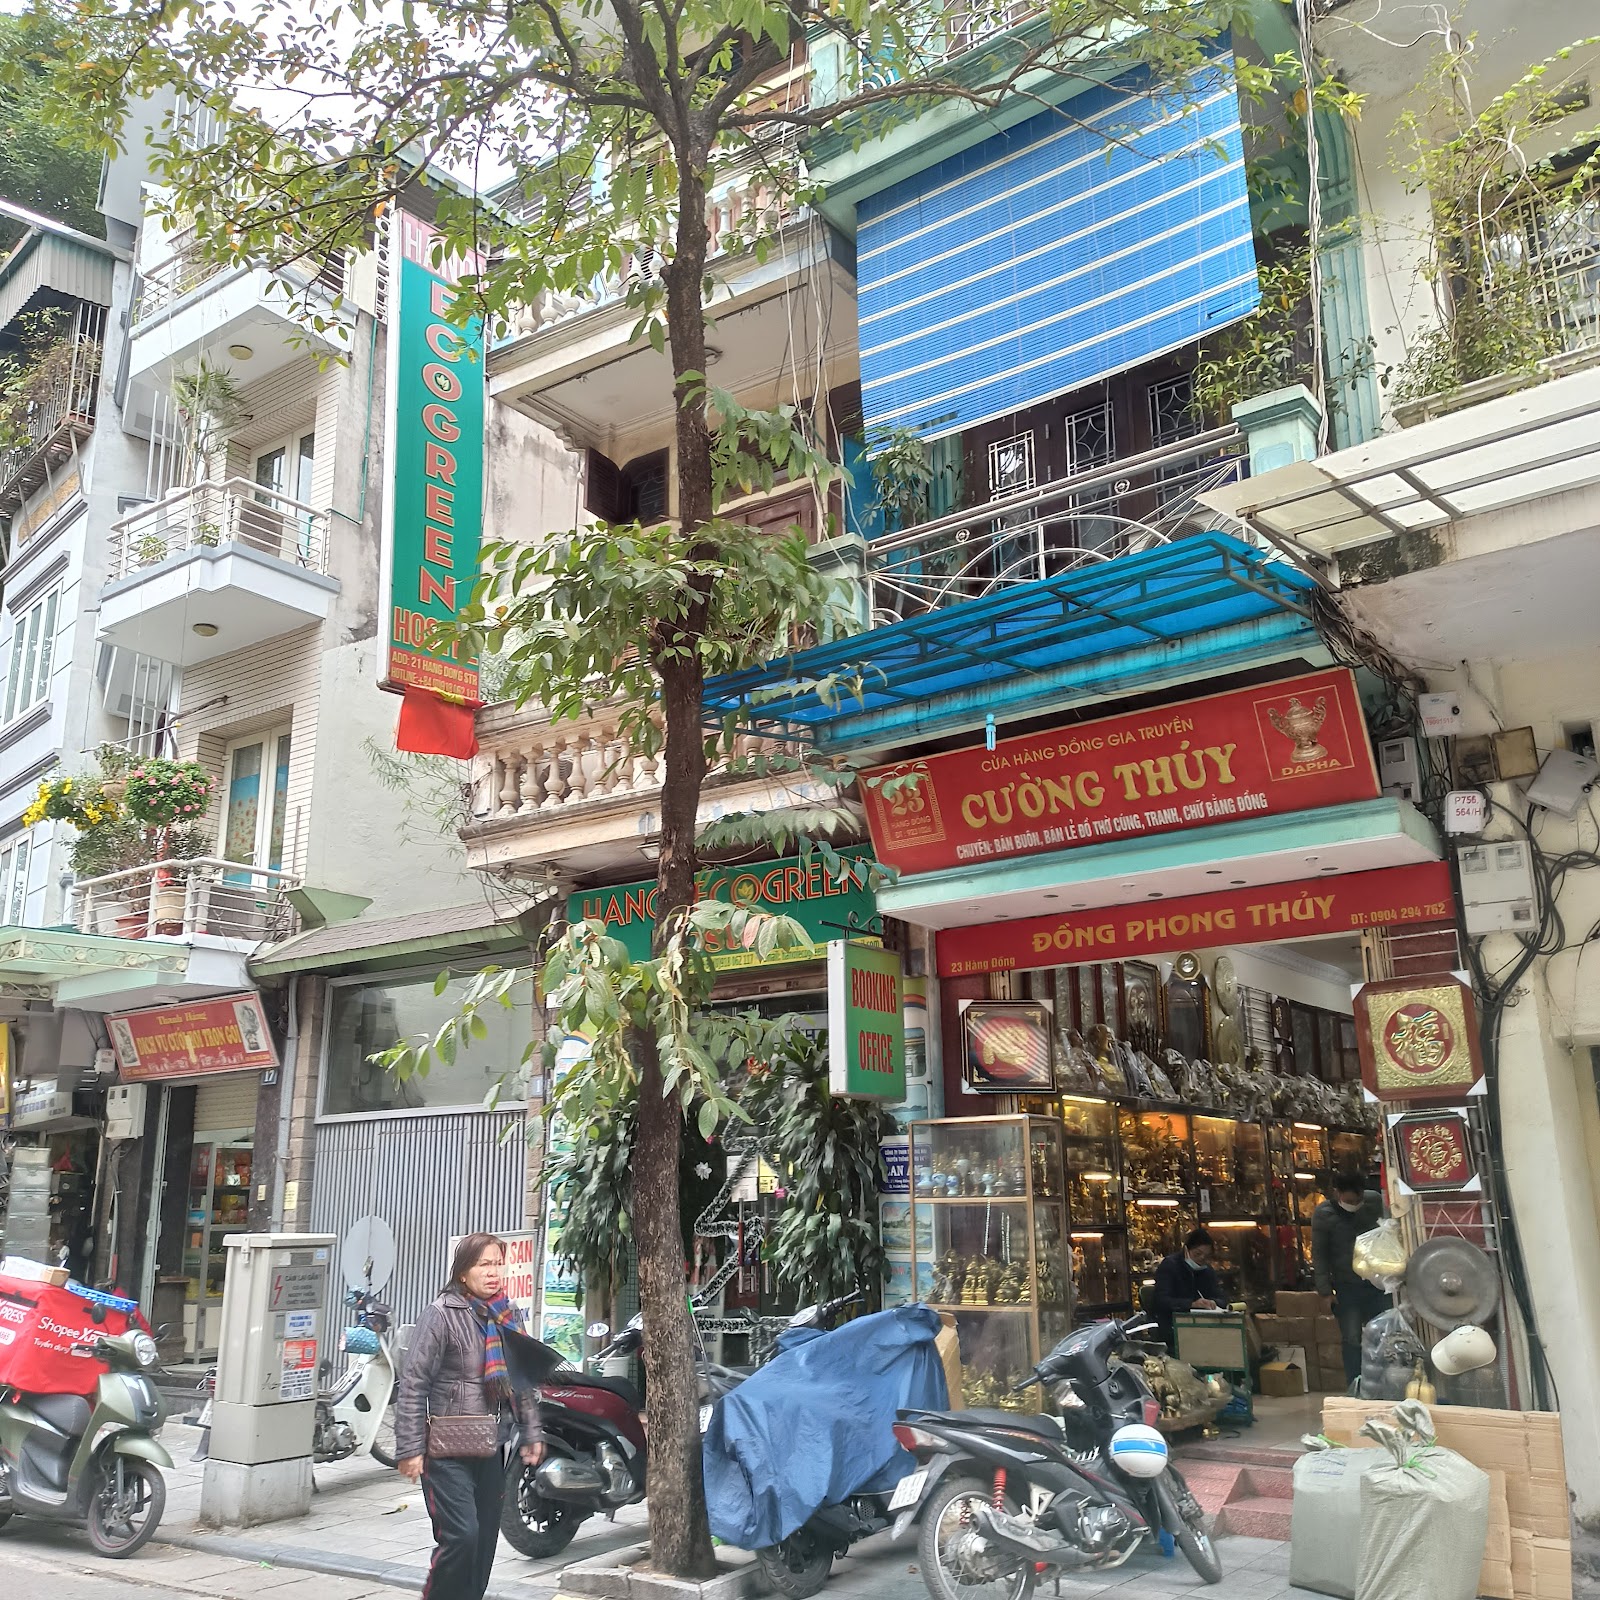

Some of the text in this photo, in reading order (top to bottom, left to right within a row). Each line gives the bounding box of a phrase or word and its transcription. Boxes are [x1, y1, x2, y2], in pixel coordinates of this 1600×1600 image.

[420, 280, 462, 613] ECOGREEN
[411, 656, 421, 669] 21
[981, 715, 1194, 772] CỬA HÀNG ĐỒNG GIA TRUYỀN
[961, 740, 1237, 828] CƯỜNG THÚY
[1281, 759, 1341, 776] DAPHA
[890, 786, 925, 816] 23
[994, 834, 1014, 852] BÁN
[1015, 830, 1044, 850] BUÔN,
[1043, 825, 1065, 843] BÁN
[1065, 818, 1078, 839] LẺ
[1078, 816, 1092, 838] ĐỒ
[1092, 814, 1113, 836] THỜ
[1114, 812, 1145, 833] CÚNG,
[1145, 807, 1182, 827] TRANH,
[1183, 798, 1207, 820] CHỮ
[1205, 794, 1236, 817] BẰNG
[1236, 790, 1268, 812] ĐỒNG
[1032, 890, 1336, 953] ĐỒNG PHONG THỦY
[1370, 909, 1397, 922] 0904
[1400, 906, 1421, 919] 294
[1423, 902, 1446, 915] 762
[951, 956, 1015, 973] 23 Hàng Đồng
[852, 967, 896, 1014] BOOKING
[858, 1030, 894, 1074] OFFICE
[264, 1070, 274, 1082] 17
